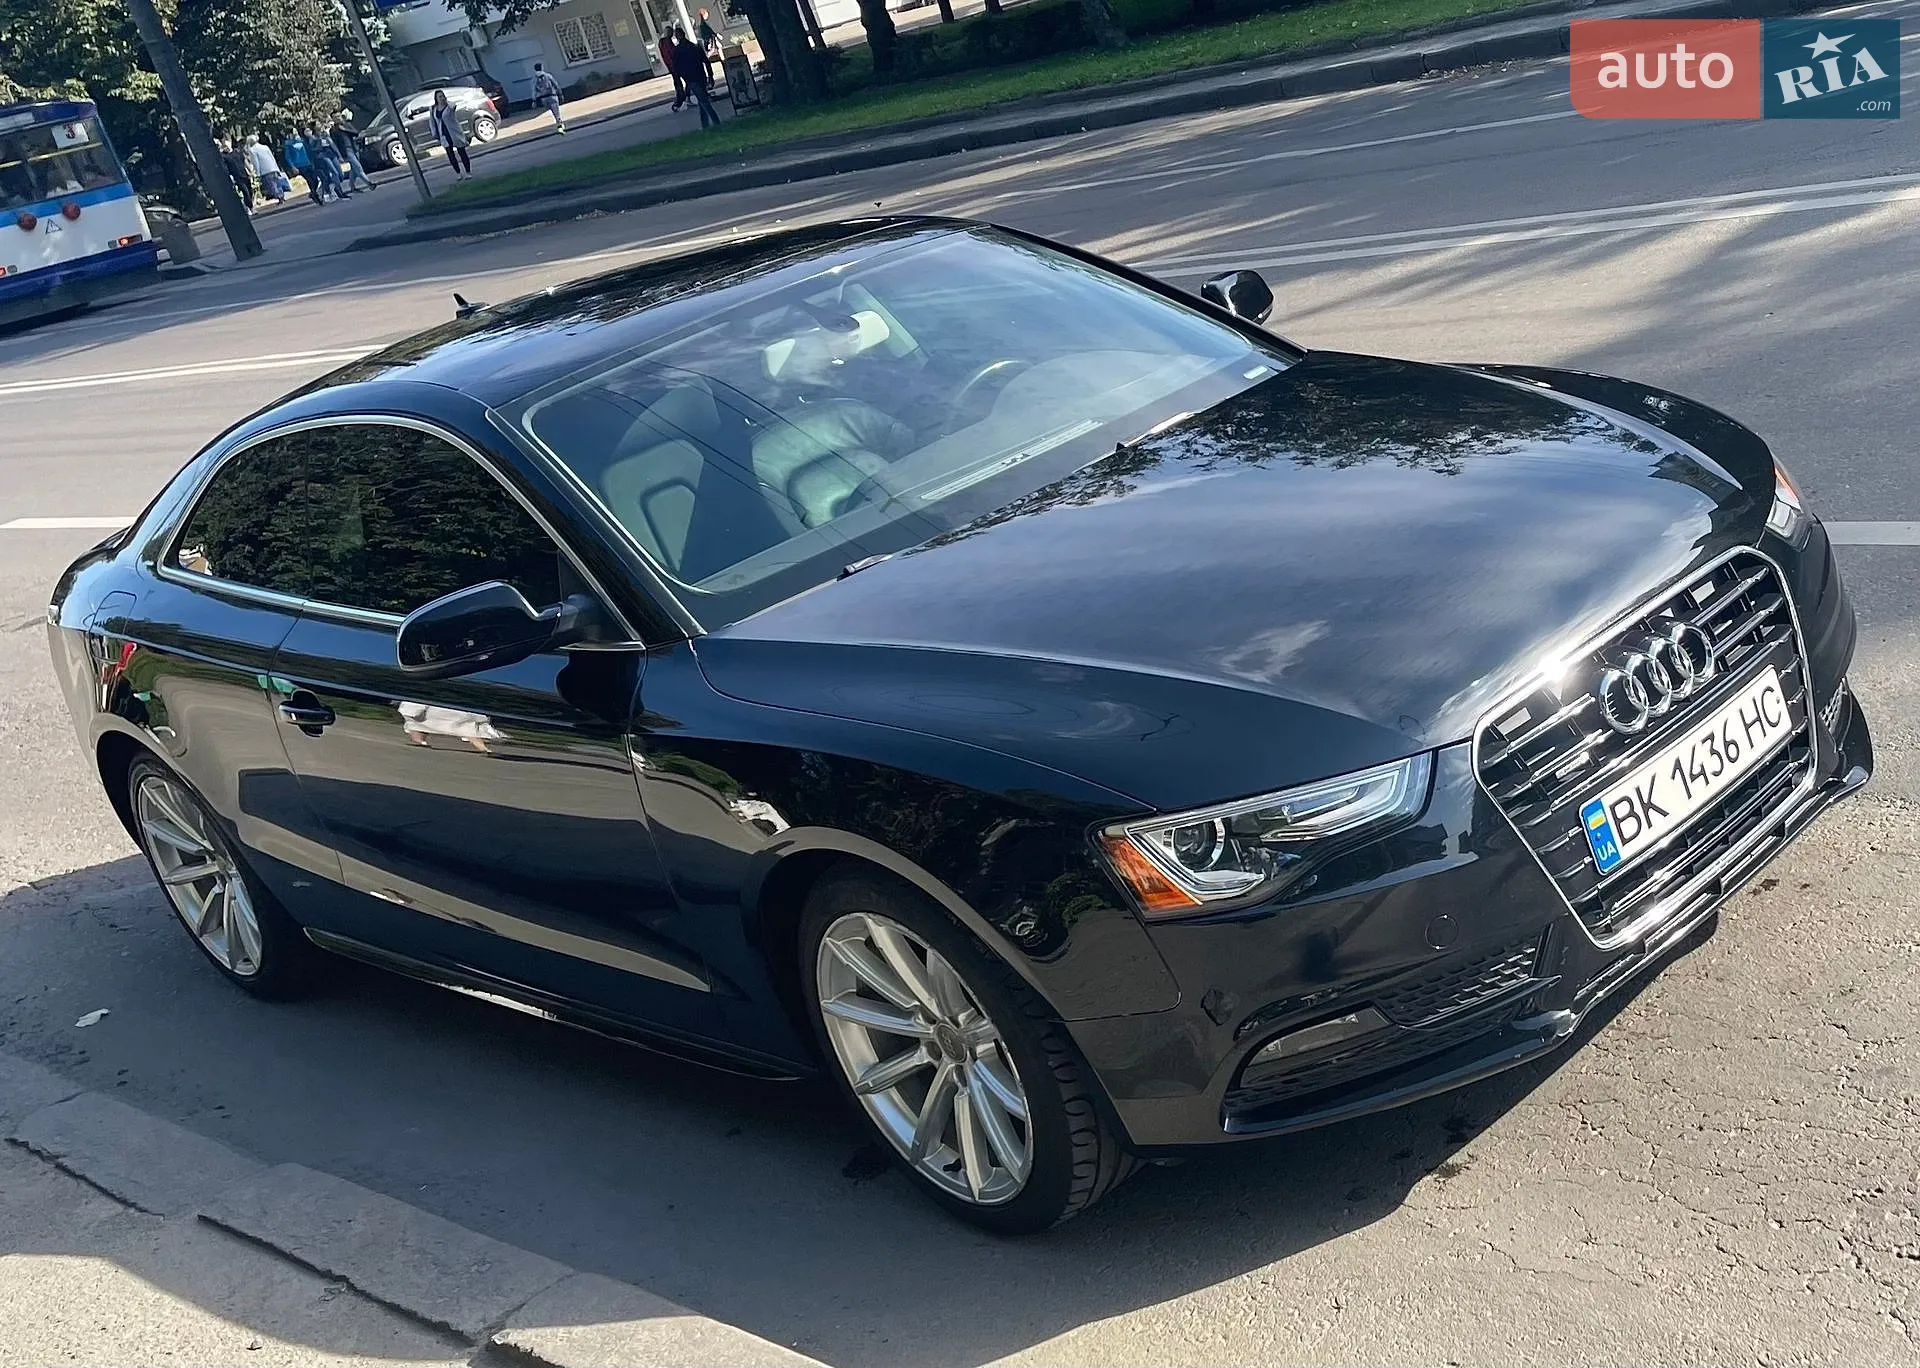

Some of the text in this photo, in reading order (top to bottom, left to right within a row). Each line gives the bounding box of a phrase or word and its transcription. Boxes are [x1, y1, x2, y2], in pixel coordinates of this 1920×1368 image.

[1609, 686, 1782, 847] BK 1436 HC
[1597, 840, 1618, 861] UA
